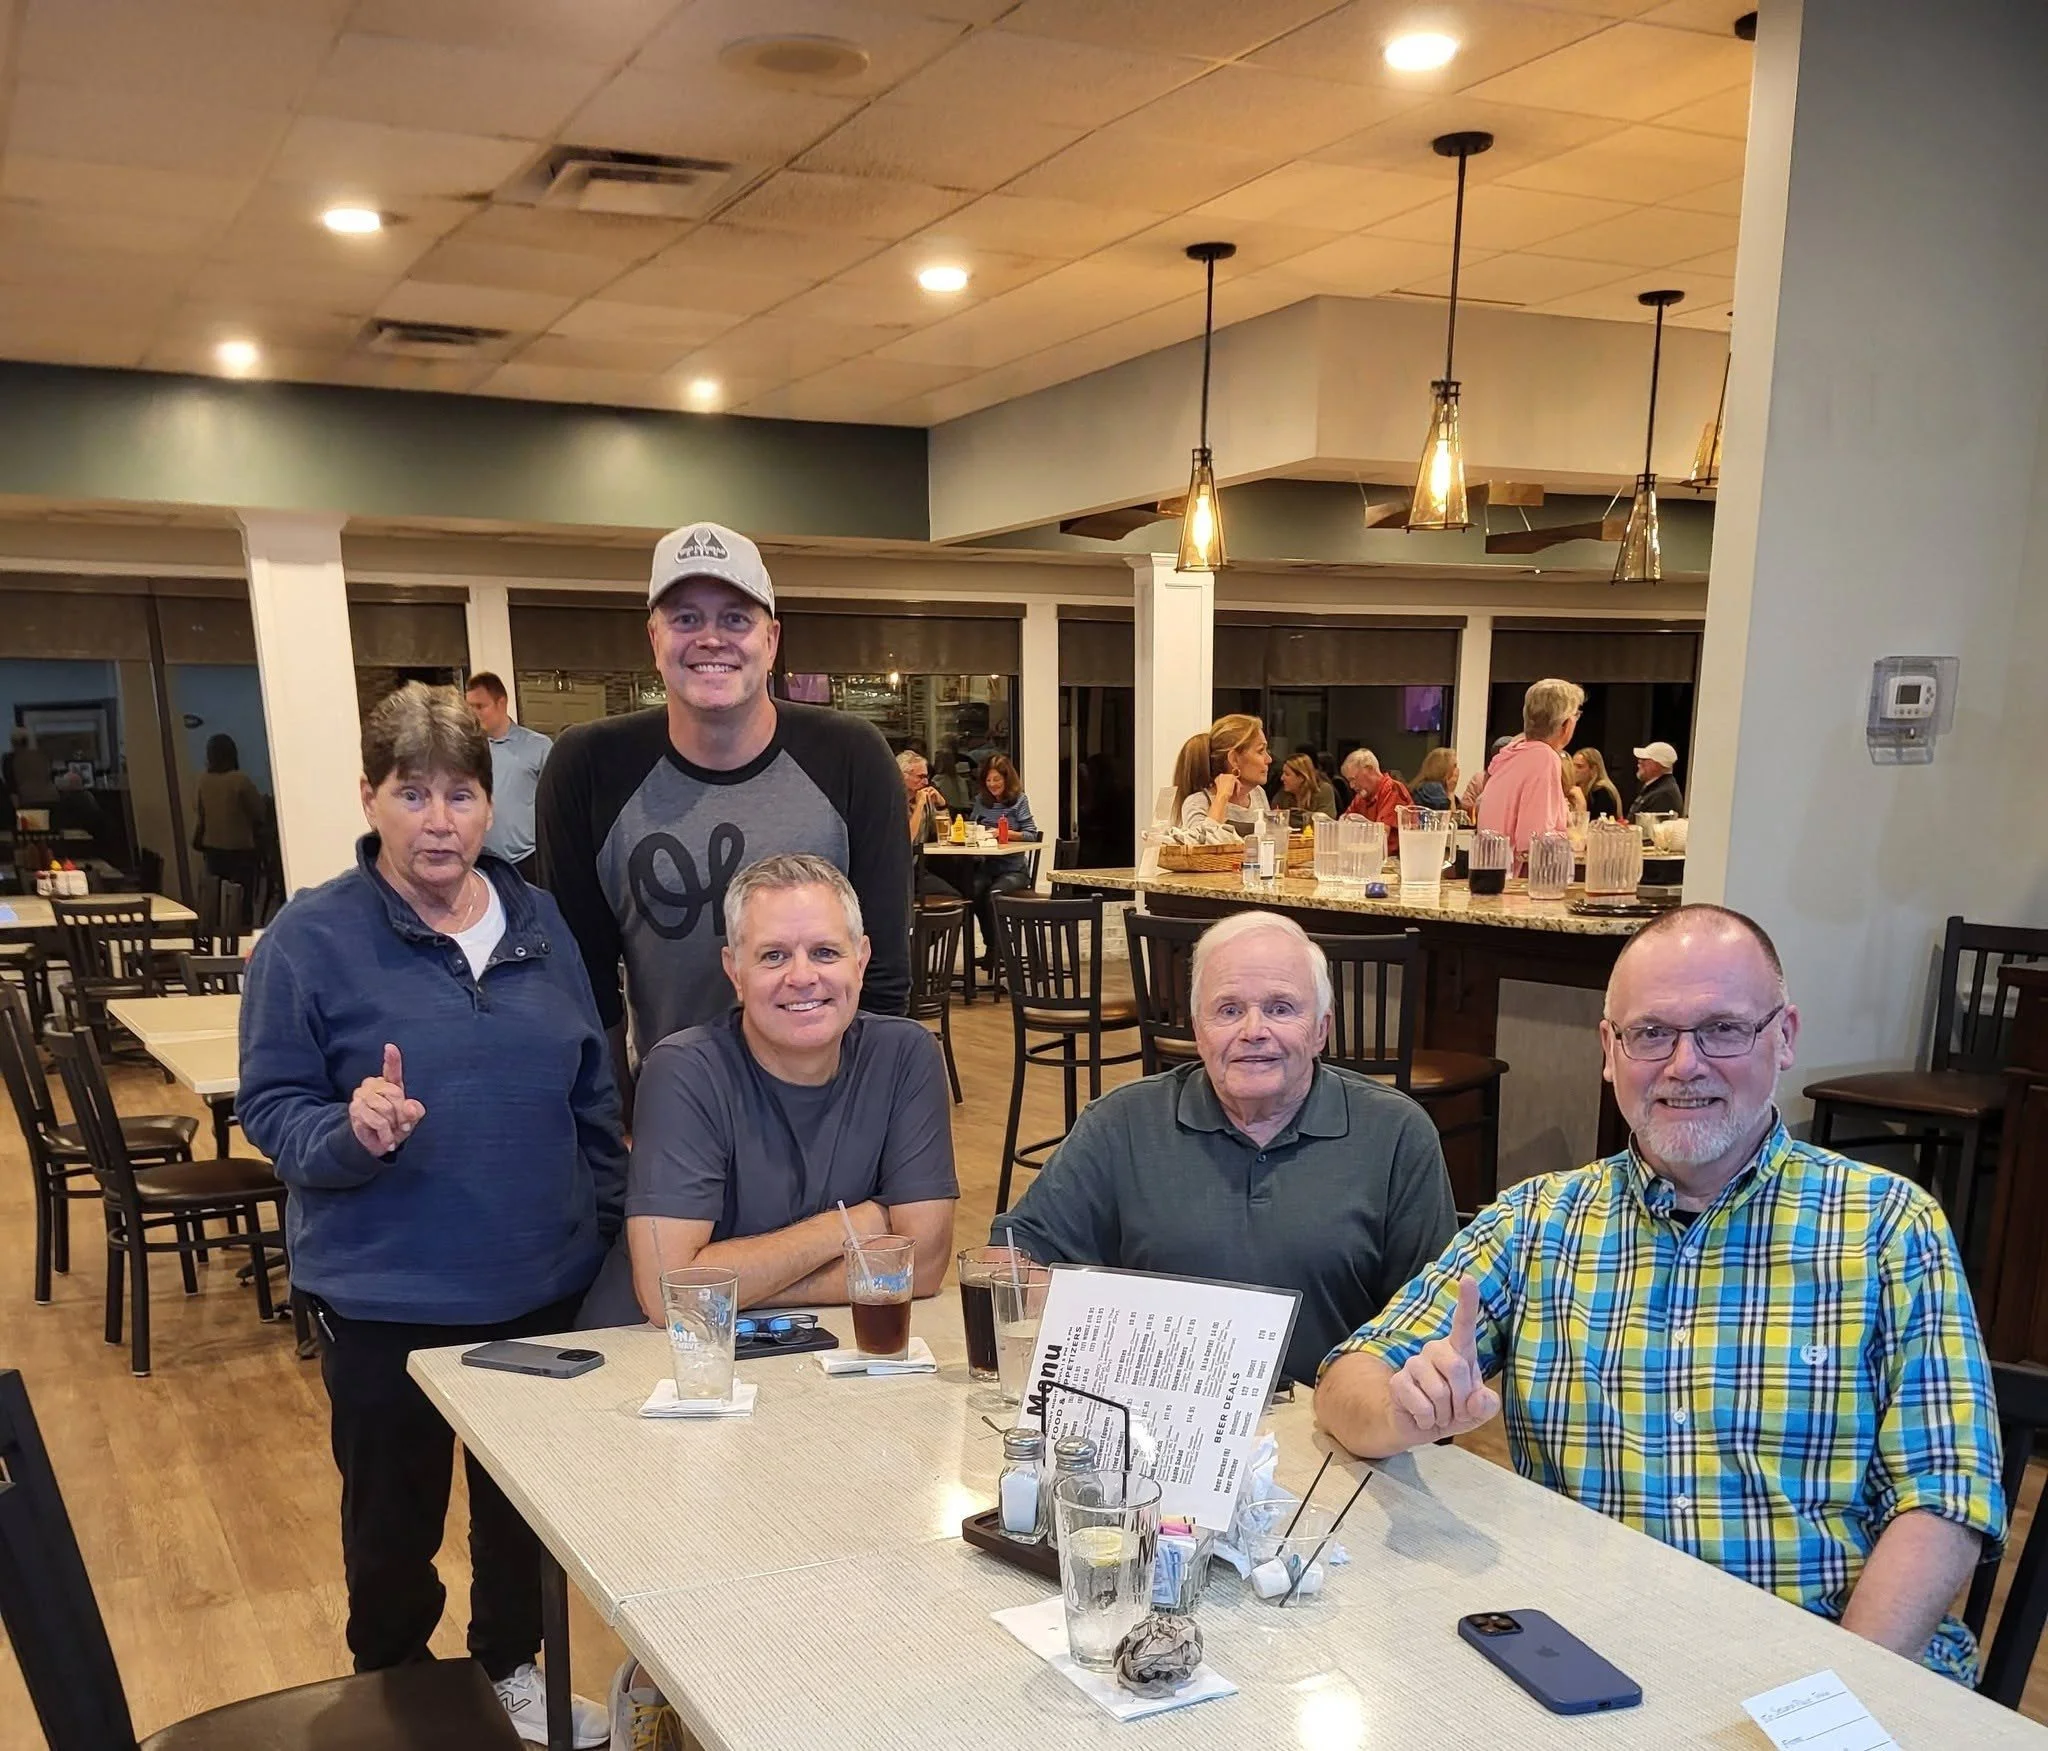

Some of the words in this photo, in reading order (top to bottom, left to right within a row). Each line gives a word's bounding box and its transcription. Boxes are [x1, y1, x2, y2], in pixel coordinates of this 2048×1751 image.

[1026, 1344, 1062, 1416] Menu
[1050, 1408, 1064, 1441] FOOD
[1058, 1397, 1066, 1405] &
[1212, 1413, 1229, 1443] BEER
[1222, 1371, 1240, 1410] DEALS
[1212, 1477, 1223, 1491] Beer
[1222, 1479, 1233, 1494] Beer
